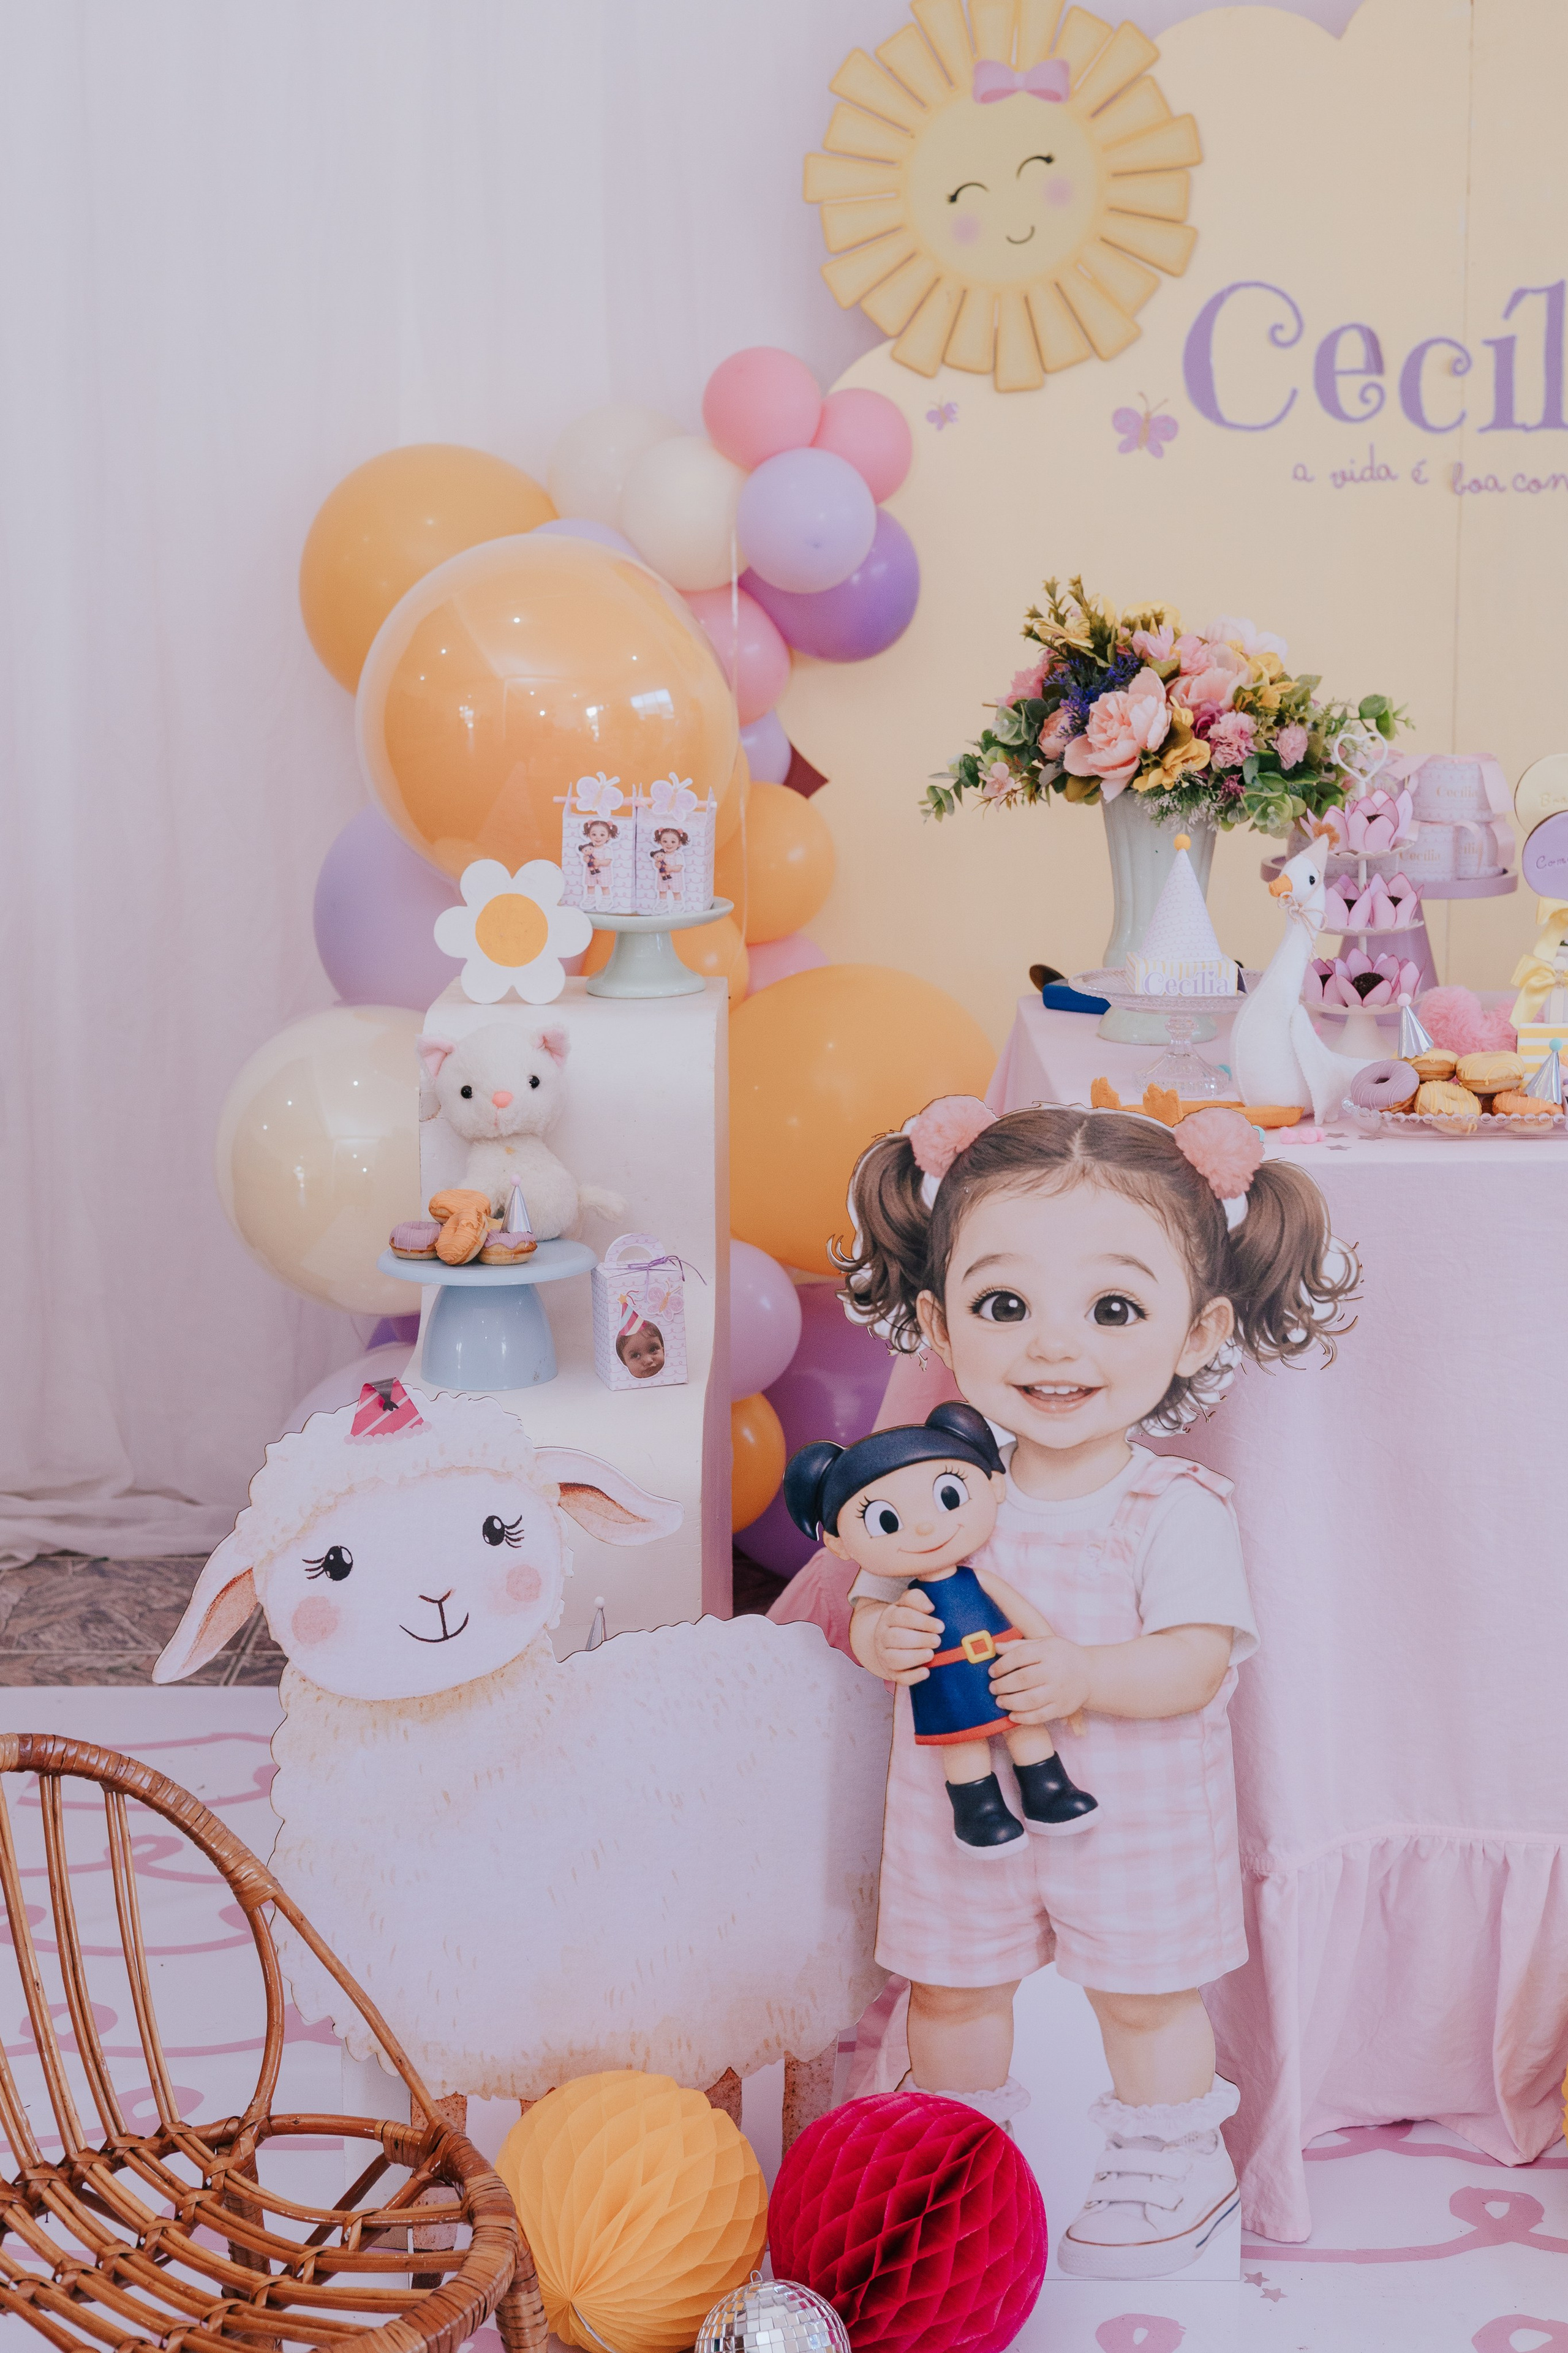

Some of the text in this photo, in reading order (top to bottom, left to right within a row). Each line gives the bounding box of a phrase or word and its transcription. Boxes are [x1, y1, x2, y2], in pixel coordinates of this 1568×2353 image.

[1292, 463, 1315, 482] a
[1330, 442, 1398, 488] vida
[1411, 458, 1429, 484] é
[1452, 461, 1506, 495] boa
